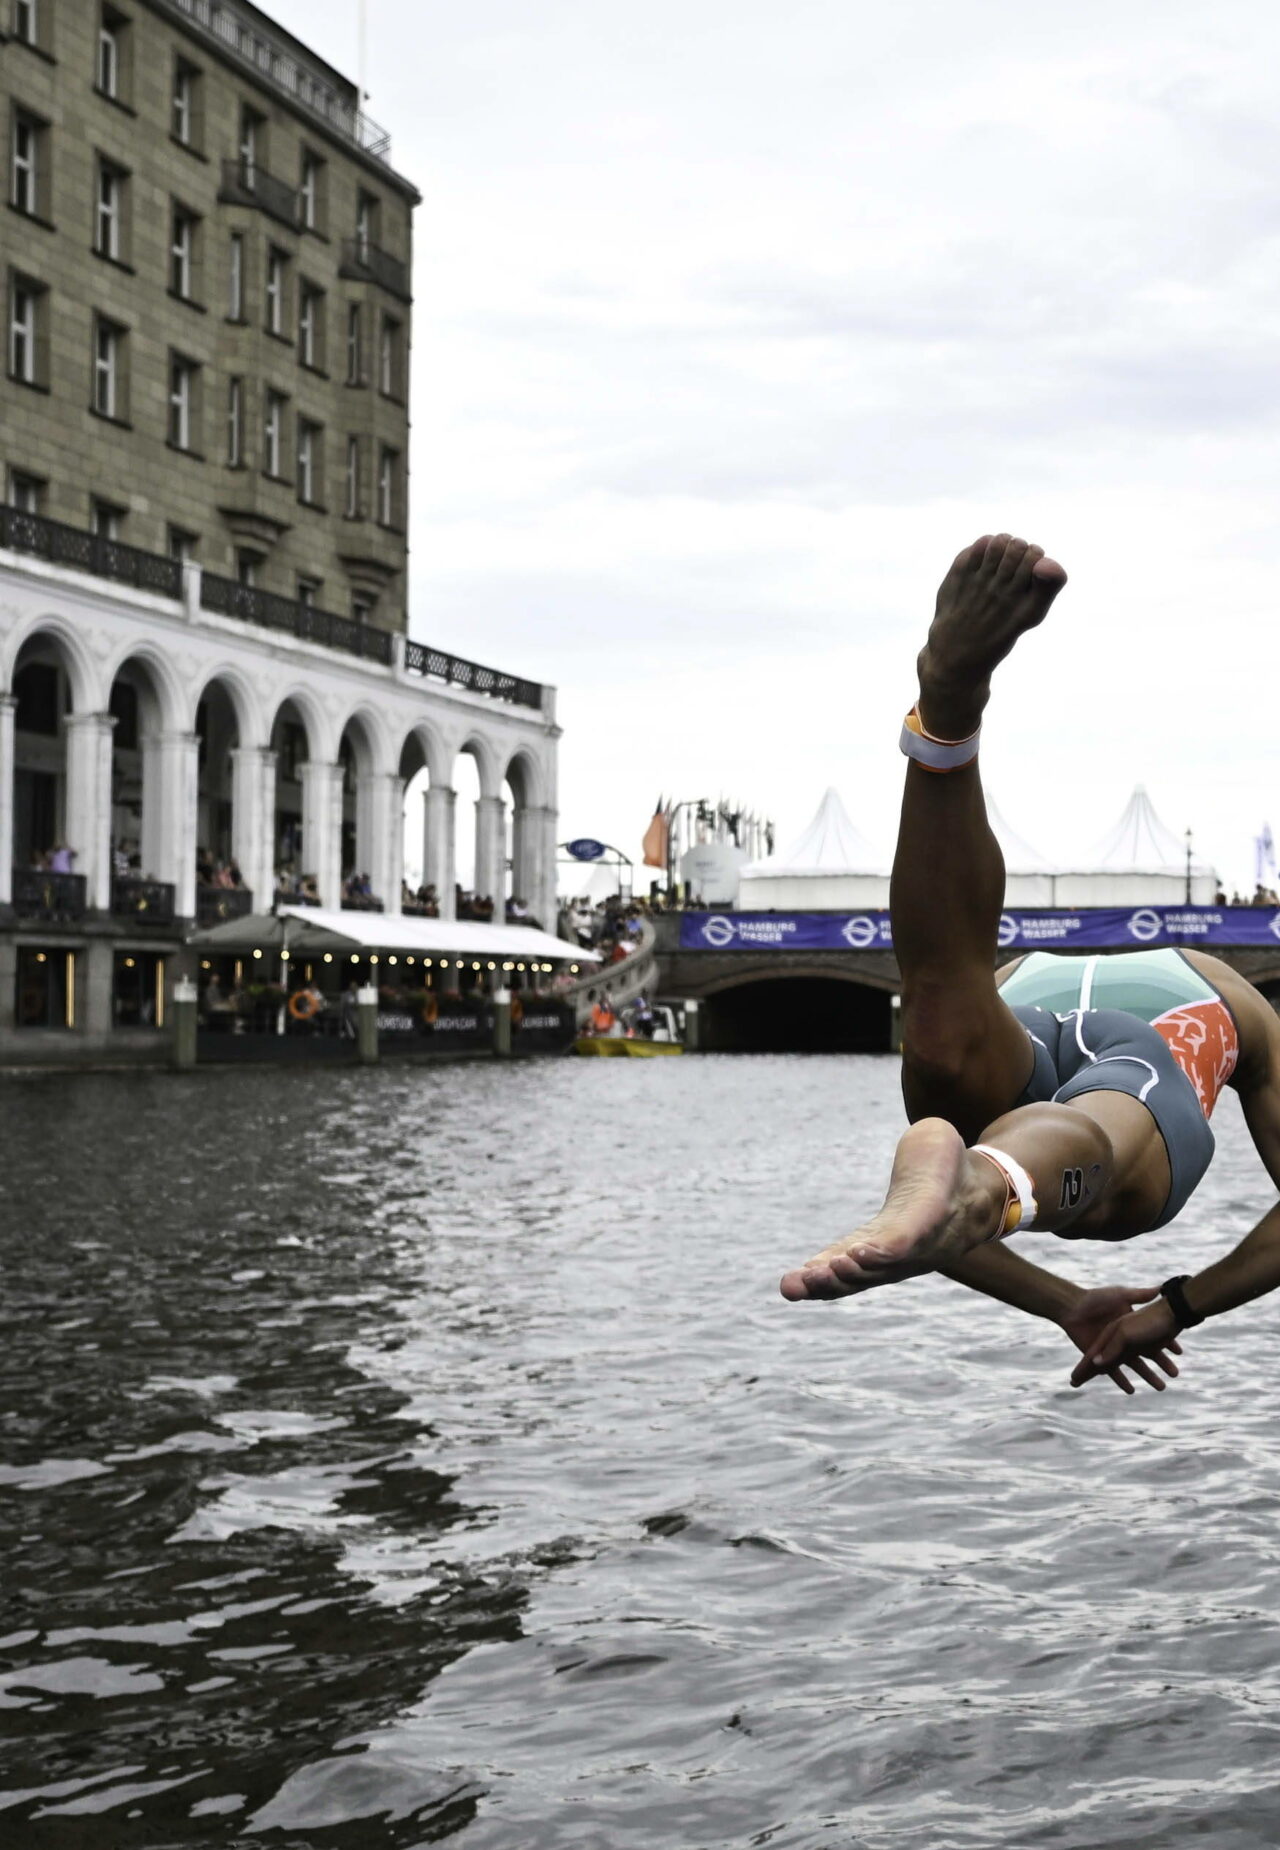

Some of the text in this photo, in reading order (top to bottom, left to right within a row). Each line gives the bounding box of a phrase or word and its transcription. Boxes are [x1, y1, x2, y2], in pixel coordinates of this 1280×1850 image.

[1022, 918, 1080, 929] HAMBURG
[1165, 913, 1222, 924] HAMBURG
[739, 921, 796, 933] HAMBURG
[1166, 924, 1208, 934] WASSER
[740, 932, 782, 942] WASSER
[1022, 928, 1067, 939] WASSER
